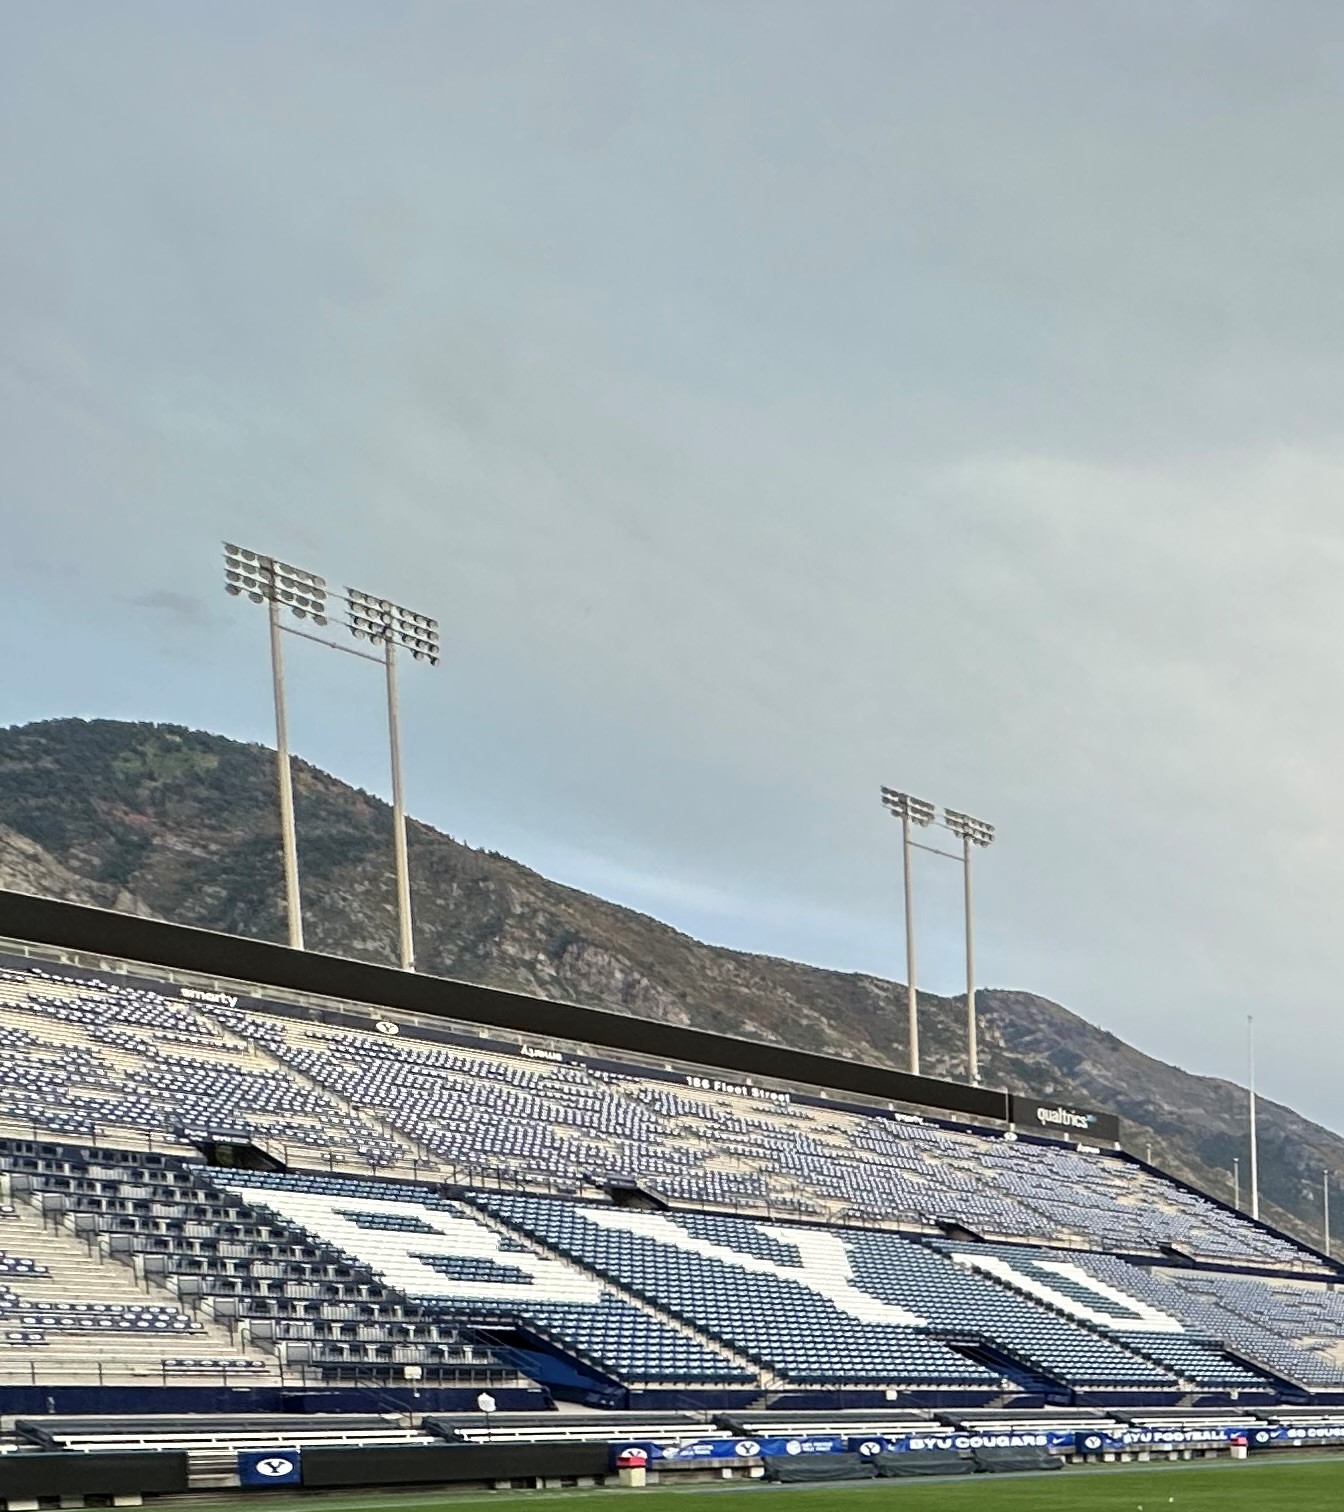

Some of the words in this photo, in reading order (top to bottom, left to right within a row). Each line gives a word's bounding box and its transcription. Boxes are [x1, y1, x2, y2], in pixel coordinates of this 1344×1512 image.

[181, 988, 238, 1007] smarty
[1037, 1107, 1088, 1129] qualtrics
[909, 1435, 952, 1450] BYU
[955, 1435, 1047, 1449] COUGARS
[1154, 1429, 1227, 1442] FOOTBALL
